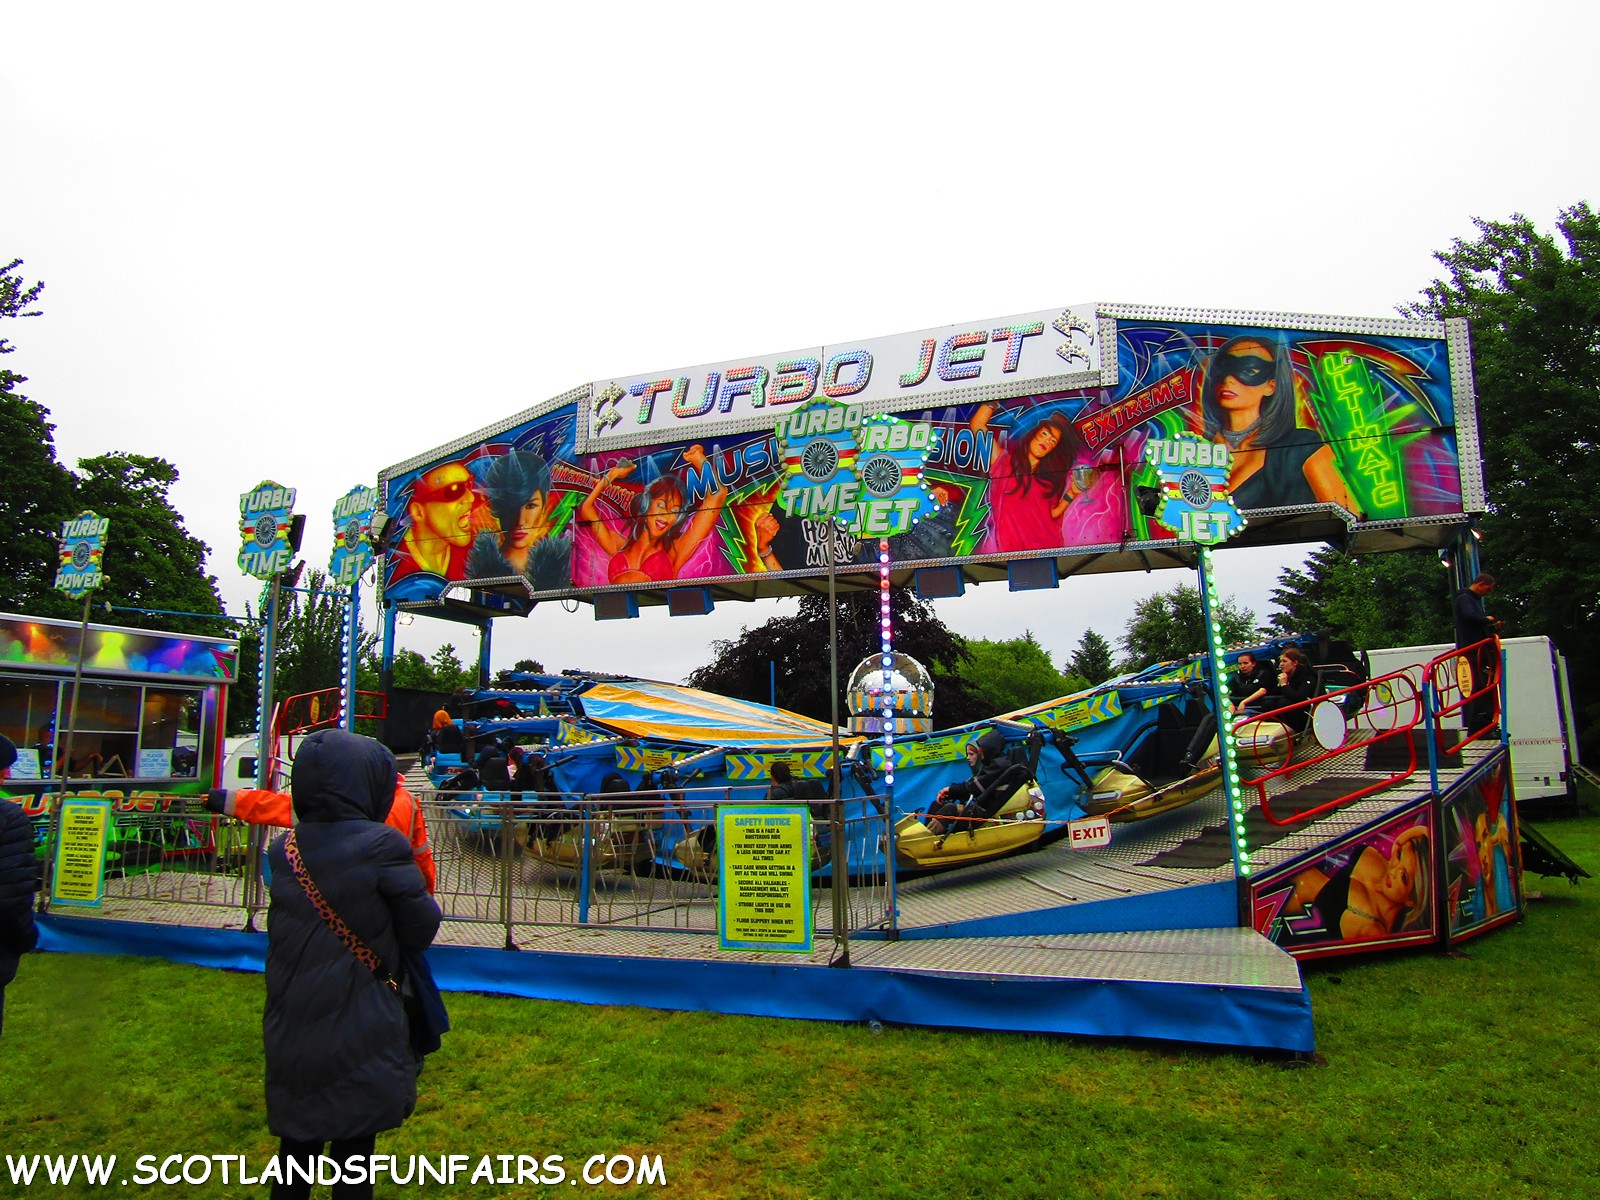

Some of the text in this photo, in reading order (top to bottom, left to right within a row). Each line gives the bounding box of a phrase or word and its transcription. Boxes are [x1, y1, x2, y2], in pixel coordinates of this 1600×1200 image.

[629, 321, 1044, 424] TURBO JET
[775, 405, 863, 438] TURBO
[1081, 375, 1187, 450] EXTREME
[861, 423, 931, 451] RBO
[1323, 350, 1399, 508] ULTIMATE
[1150, 439, 1229, 467] TURBO
[686, 437, 780, 506] MUSI
[239, 489, 295, 512] TURBO
[336, 488, 378, 519] TURBO
[782, 482, 860, 518] TIME
[61, 518, 108, 539] TURBO
[850, 500, 919, 533] JET
[1179, 512, 1229, 541] JET
[241, 551, 289, 576] TIME
[337, 553, 365, 584] JET
[54, 572, 102, 589] POWER
[735, 818, 791, 826] SAFETY NOTICE
[1073, 826, 1105, 840] EXIT
